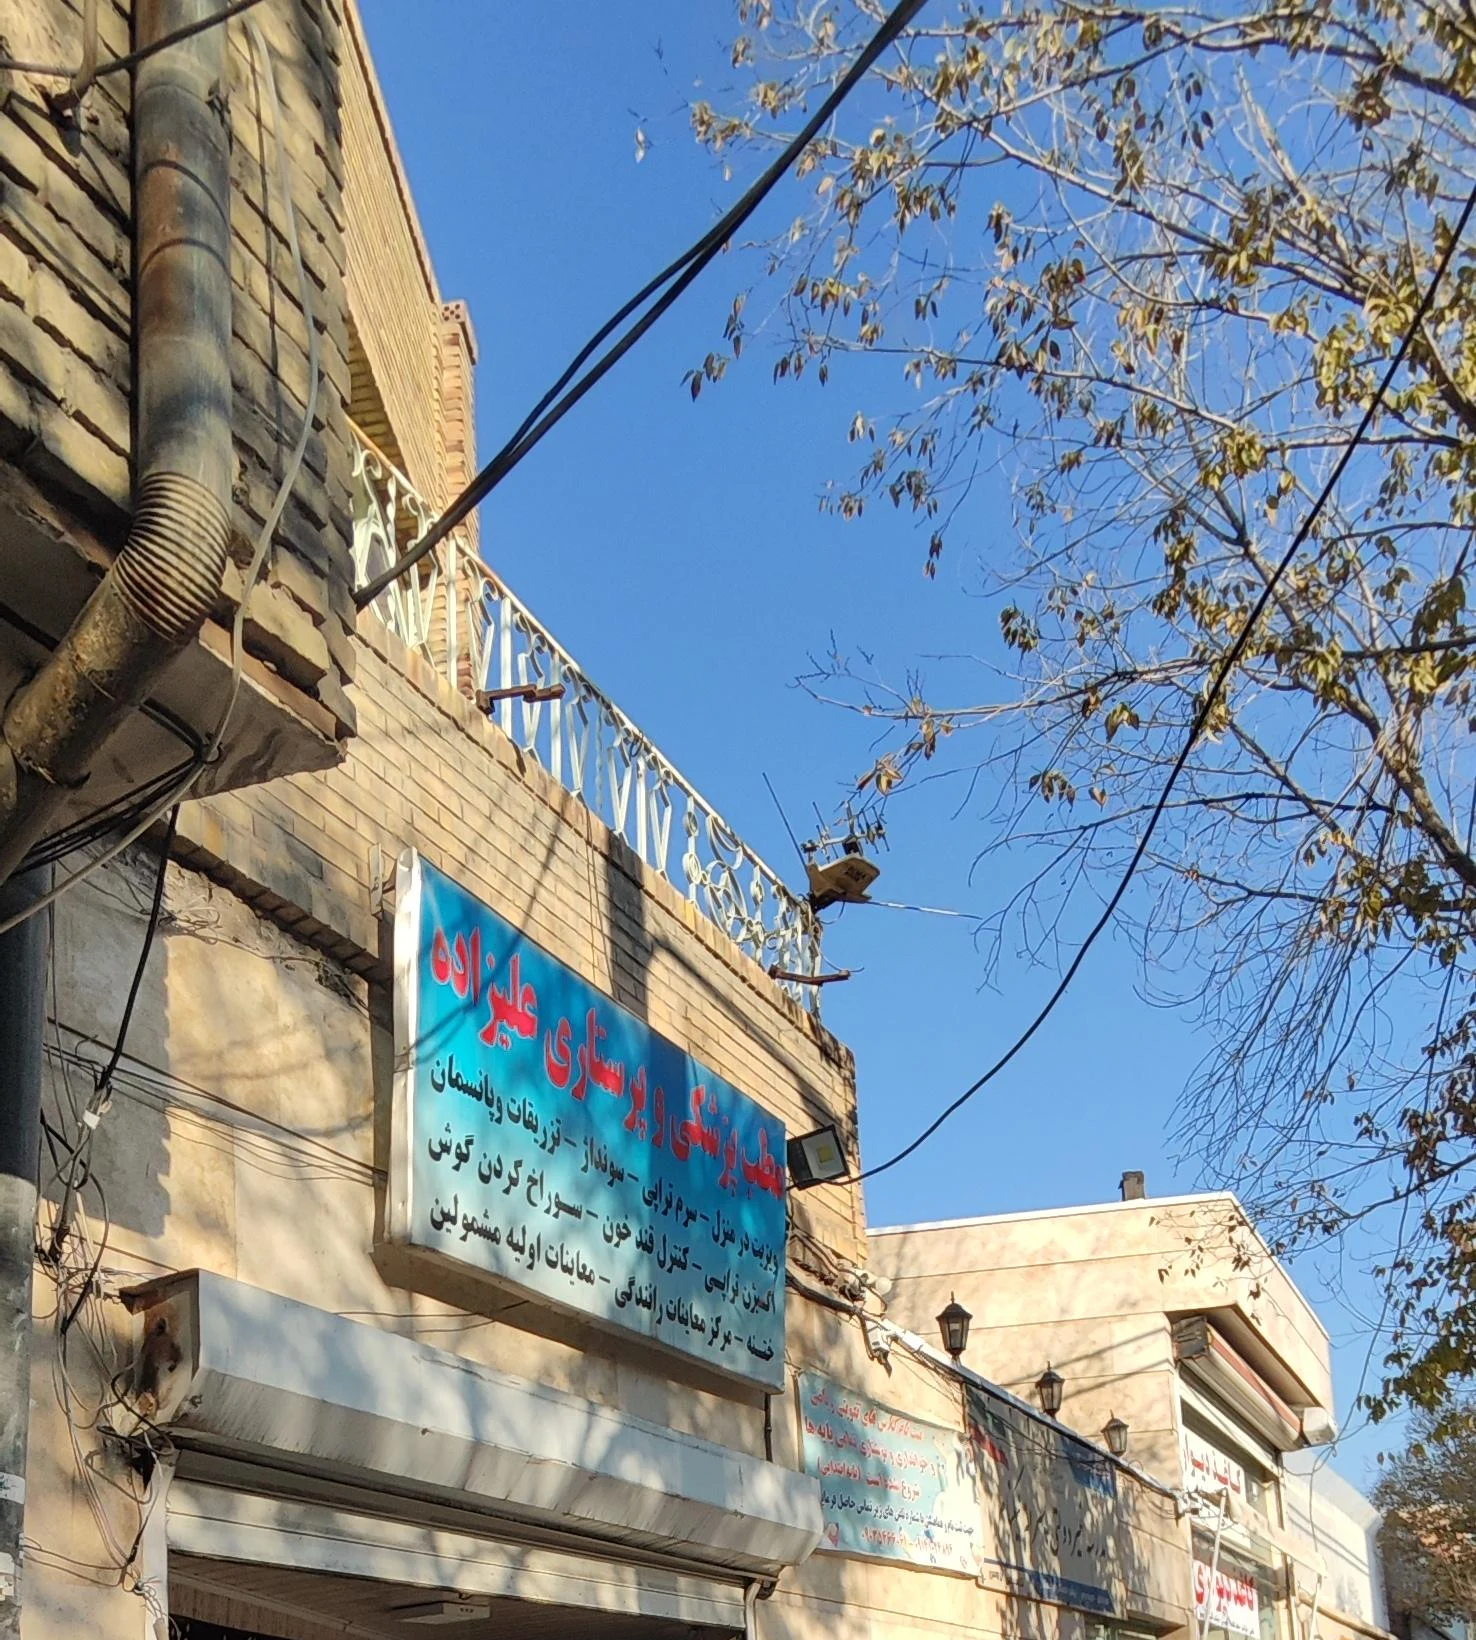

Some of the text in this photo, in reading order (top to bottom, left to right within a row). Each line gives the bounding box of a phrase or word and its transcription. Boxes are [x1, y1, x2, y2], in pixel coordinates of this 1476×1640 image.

[431, 926, 785, 1200] مطب پزشکی و پرستاری علیزاده
[506, 1097, 561, 1154] تزریقات
[428, 1122, 475, 1171] گوش
[580, 1136, 624, 1187] سونداژ
[478, 1152, 523, 1195] کردن
[526, 1168, 583, 1219] سوراخ
[642, 1177, 673, 1216] تراپی
[675, 1196, 697, 1227] سرم
[603, 1214, 631, 1247] خون
[635, 1225, 654, 1254] قند
[712, 1210, 736, 1247] منزل
[738, 1232, 749, 1256] در
[657, 1234, 689, 1273] کنترل
[430, 1193, 774, 1361] ختنه مرکز معاینات رانندگی معاینات اولیه مشمولین
[705, 1269, 739, 1304] تراپی
